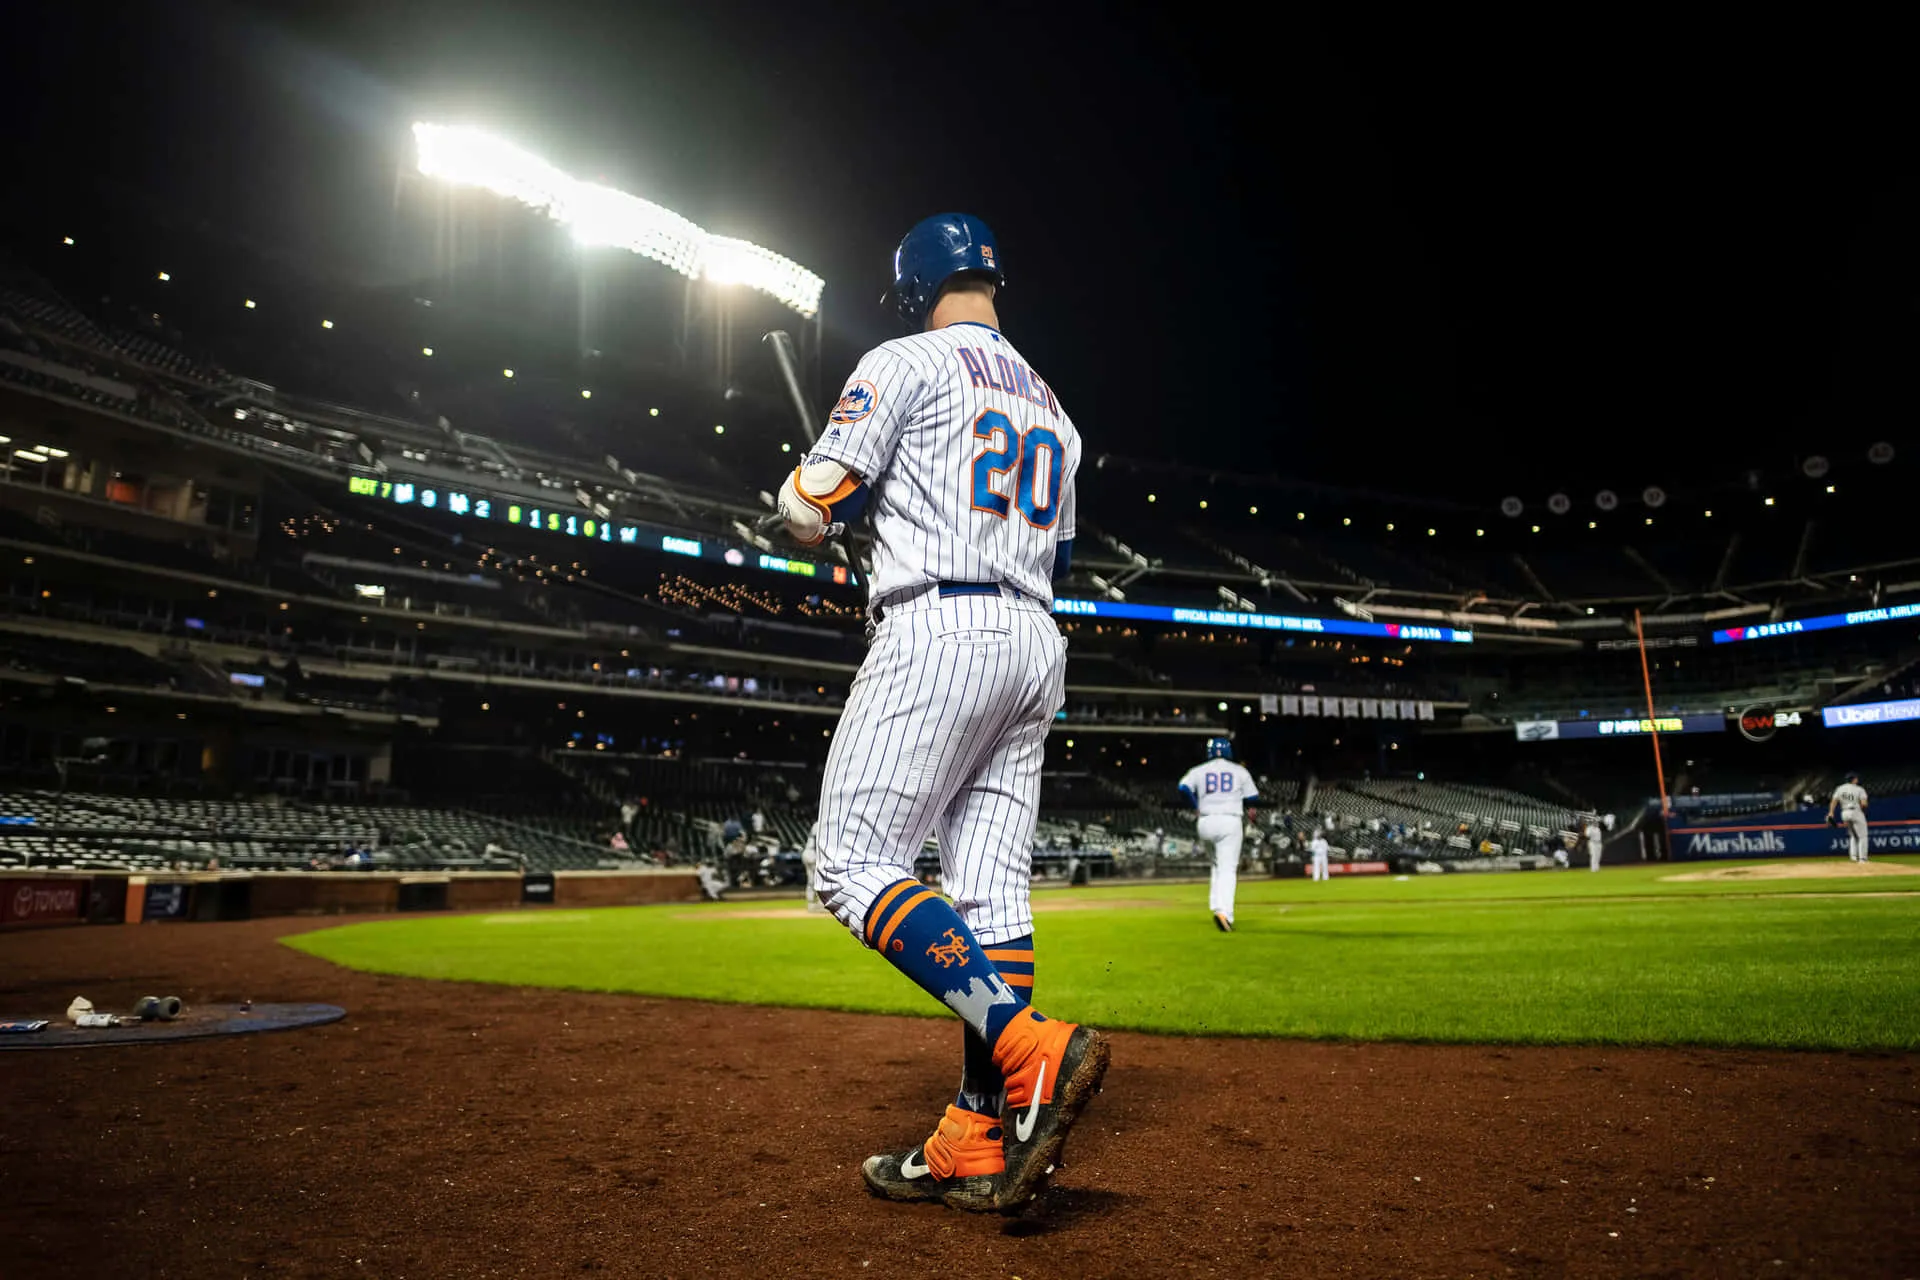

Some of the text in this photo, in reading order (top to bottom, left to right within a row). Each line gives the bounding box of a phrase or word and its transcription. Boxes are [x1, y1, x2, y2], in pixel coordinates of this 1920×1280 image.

[957, 347, 1059, 420] ALONSO
[970, 407, 1065, 530] 20
[350, 477, 378, 496] BOT
[381, 482, 392, 498] 7
[475, 500, 491, 518] 2
[529, 509, 541, 529] 1
[566, 516, 578, 535] 1
[600, 522, 612, 542] 1
[1055, 599, 1097, 614] DELTA
[1846, 608, 1889, 624] OFFICIAL
[1410, 625, 1442, 639] DELTA
[1759, 620, 1803, 637] DELTA
[1836, 707, 1880, 723] Uber
[1206, 771, 1233, 794] BB
[1688, 831, 1786, 854] Marshalls
[34, 888, 76, 912] TOYOTA
